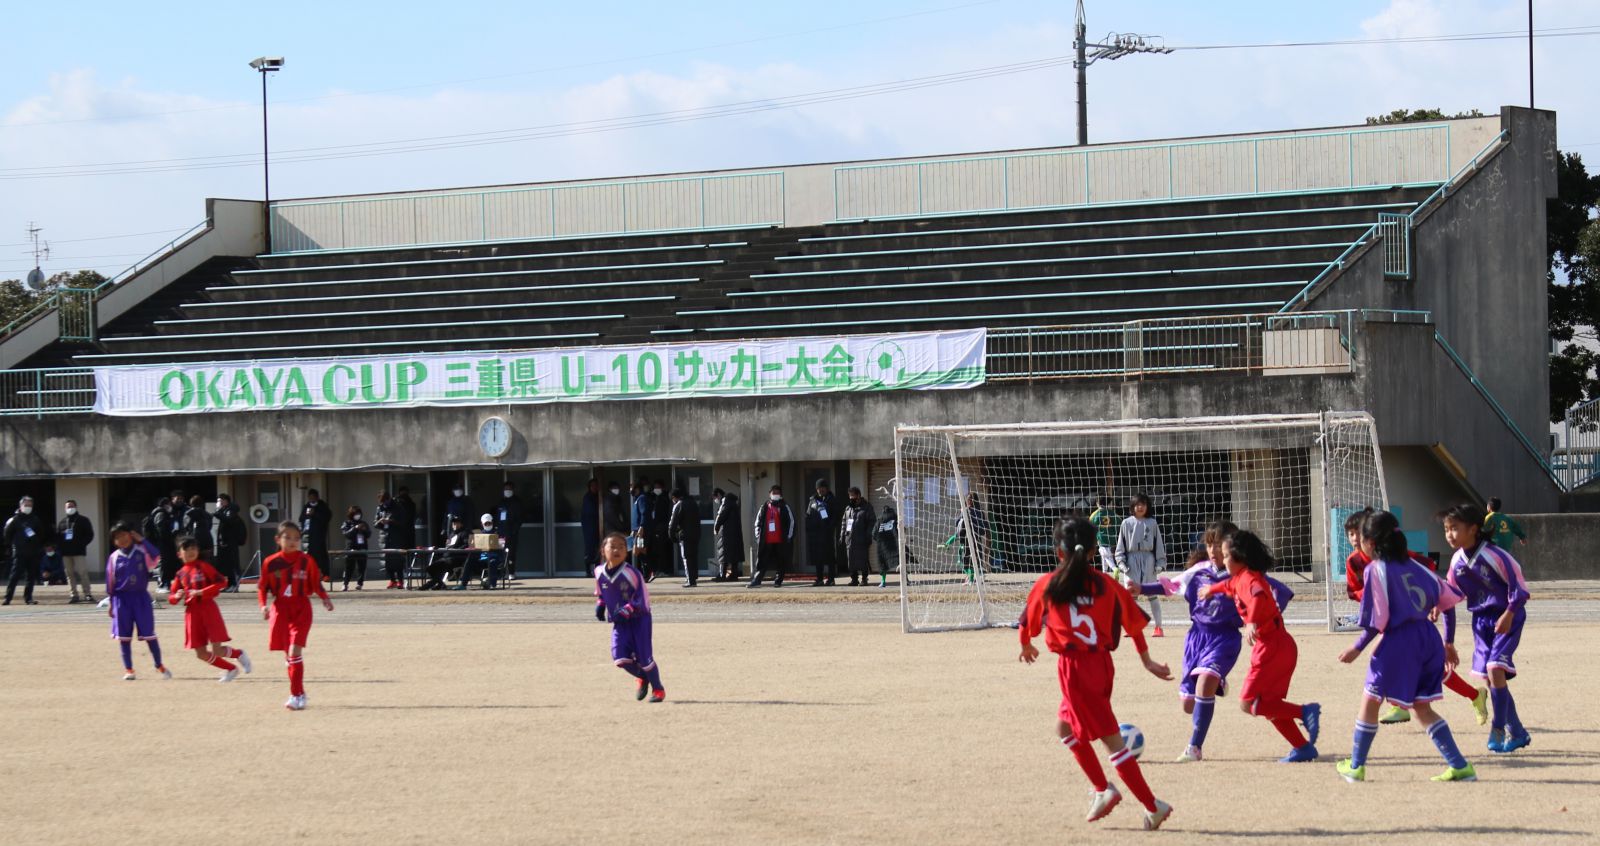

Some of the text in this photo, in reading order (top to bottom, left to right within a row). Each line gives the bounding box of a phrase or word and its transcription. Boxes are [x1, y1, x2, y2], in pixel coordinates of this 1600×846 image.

[160, 345, 853, 410] OKAYA CUP 三重県 U-10 サッカー大会
[283, 584, 292, 597] 4
[1403, 574, 1427, 612] 5
[1068, 604, 1097, 645] 5
